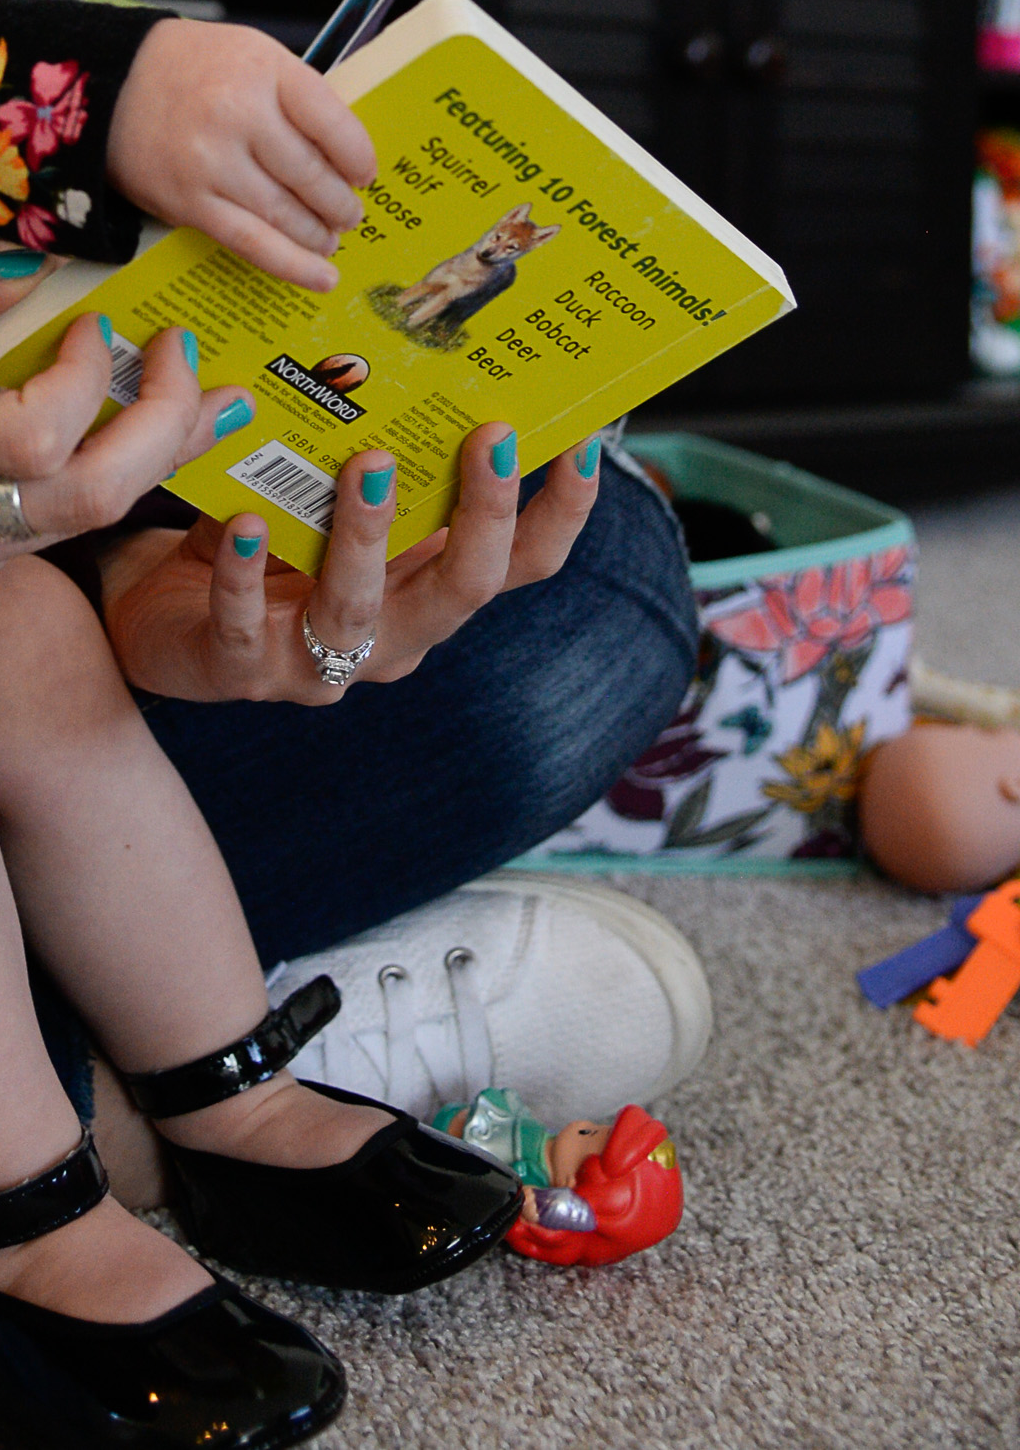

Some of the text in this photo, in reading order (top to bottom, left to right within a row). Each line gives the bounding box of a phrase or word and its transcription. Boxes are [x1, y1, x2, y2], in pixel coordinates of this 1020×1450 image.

[392, 156, 444, 194] Wolf
[420, 136, 500, 197] Squirrel
[359, 178, 422, 230] Moose
[434, 87, 726, 326] Featuring 10 Forest Animals!
[553, 289, 602, 328] Duck
[583, 270, 655, 330] Raccoon
[495, 327, 541, 362] Deer
[524, 308, 591, 359] Bobcat
[466, 346, 512, 380] Bear
[257, 372, 337, 429] Books for Young Readers
[422, 397, 432, 405] All
[429, 403, 445, 416] rights
[281, 429, 318, 454] ISBN
[358, 437, 374, 450] Card
[367, 431, 387, 447] Library
[391, 448, 417, 467] Congress
[415, 464, 437, 482] Catalog
[420, 438, 432, 448] MN
[427, 432, 444, 445] Drive
[243, 452, 263, 466] EAN
